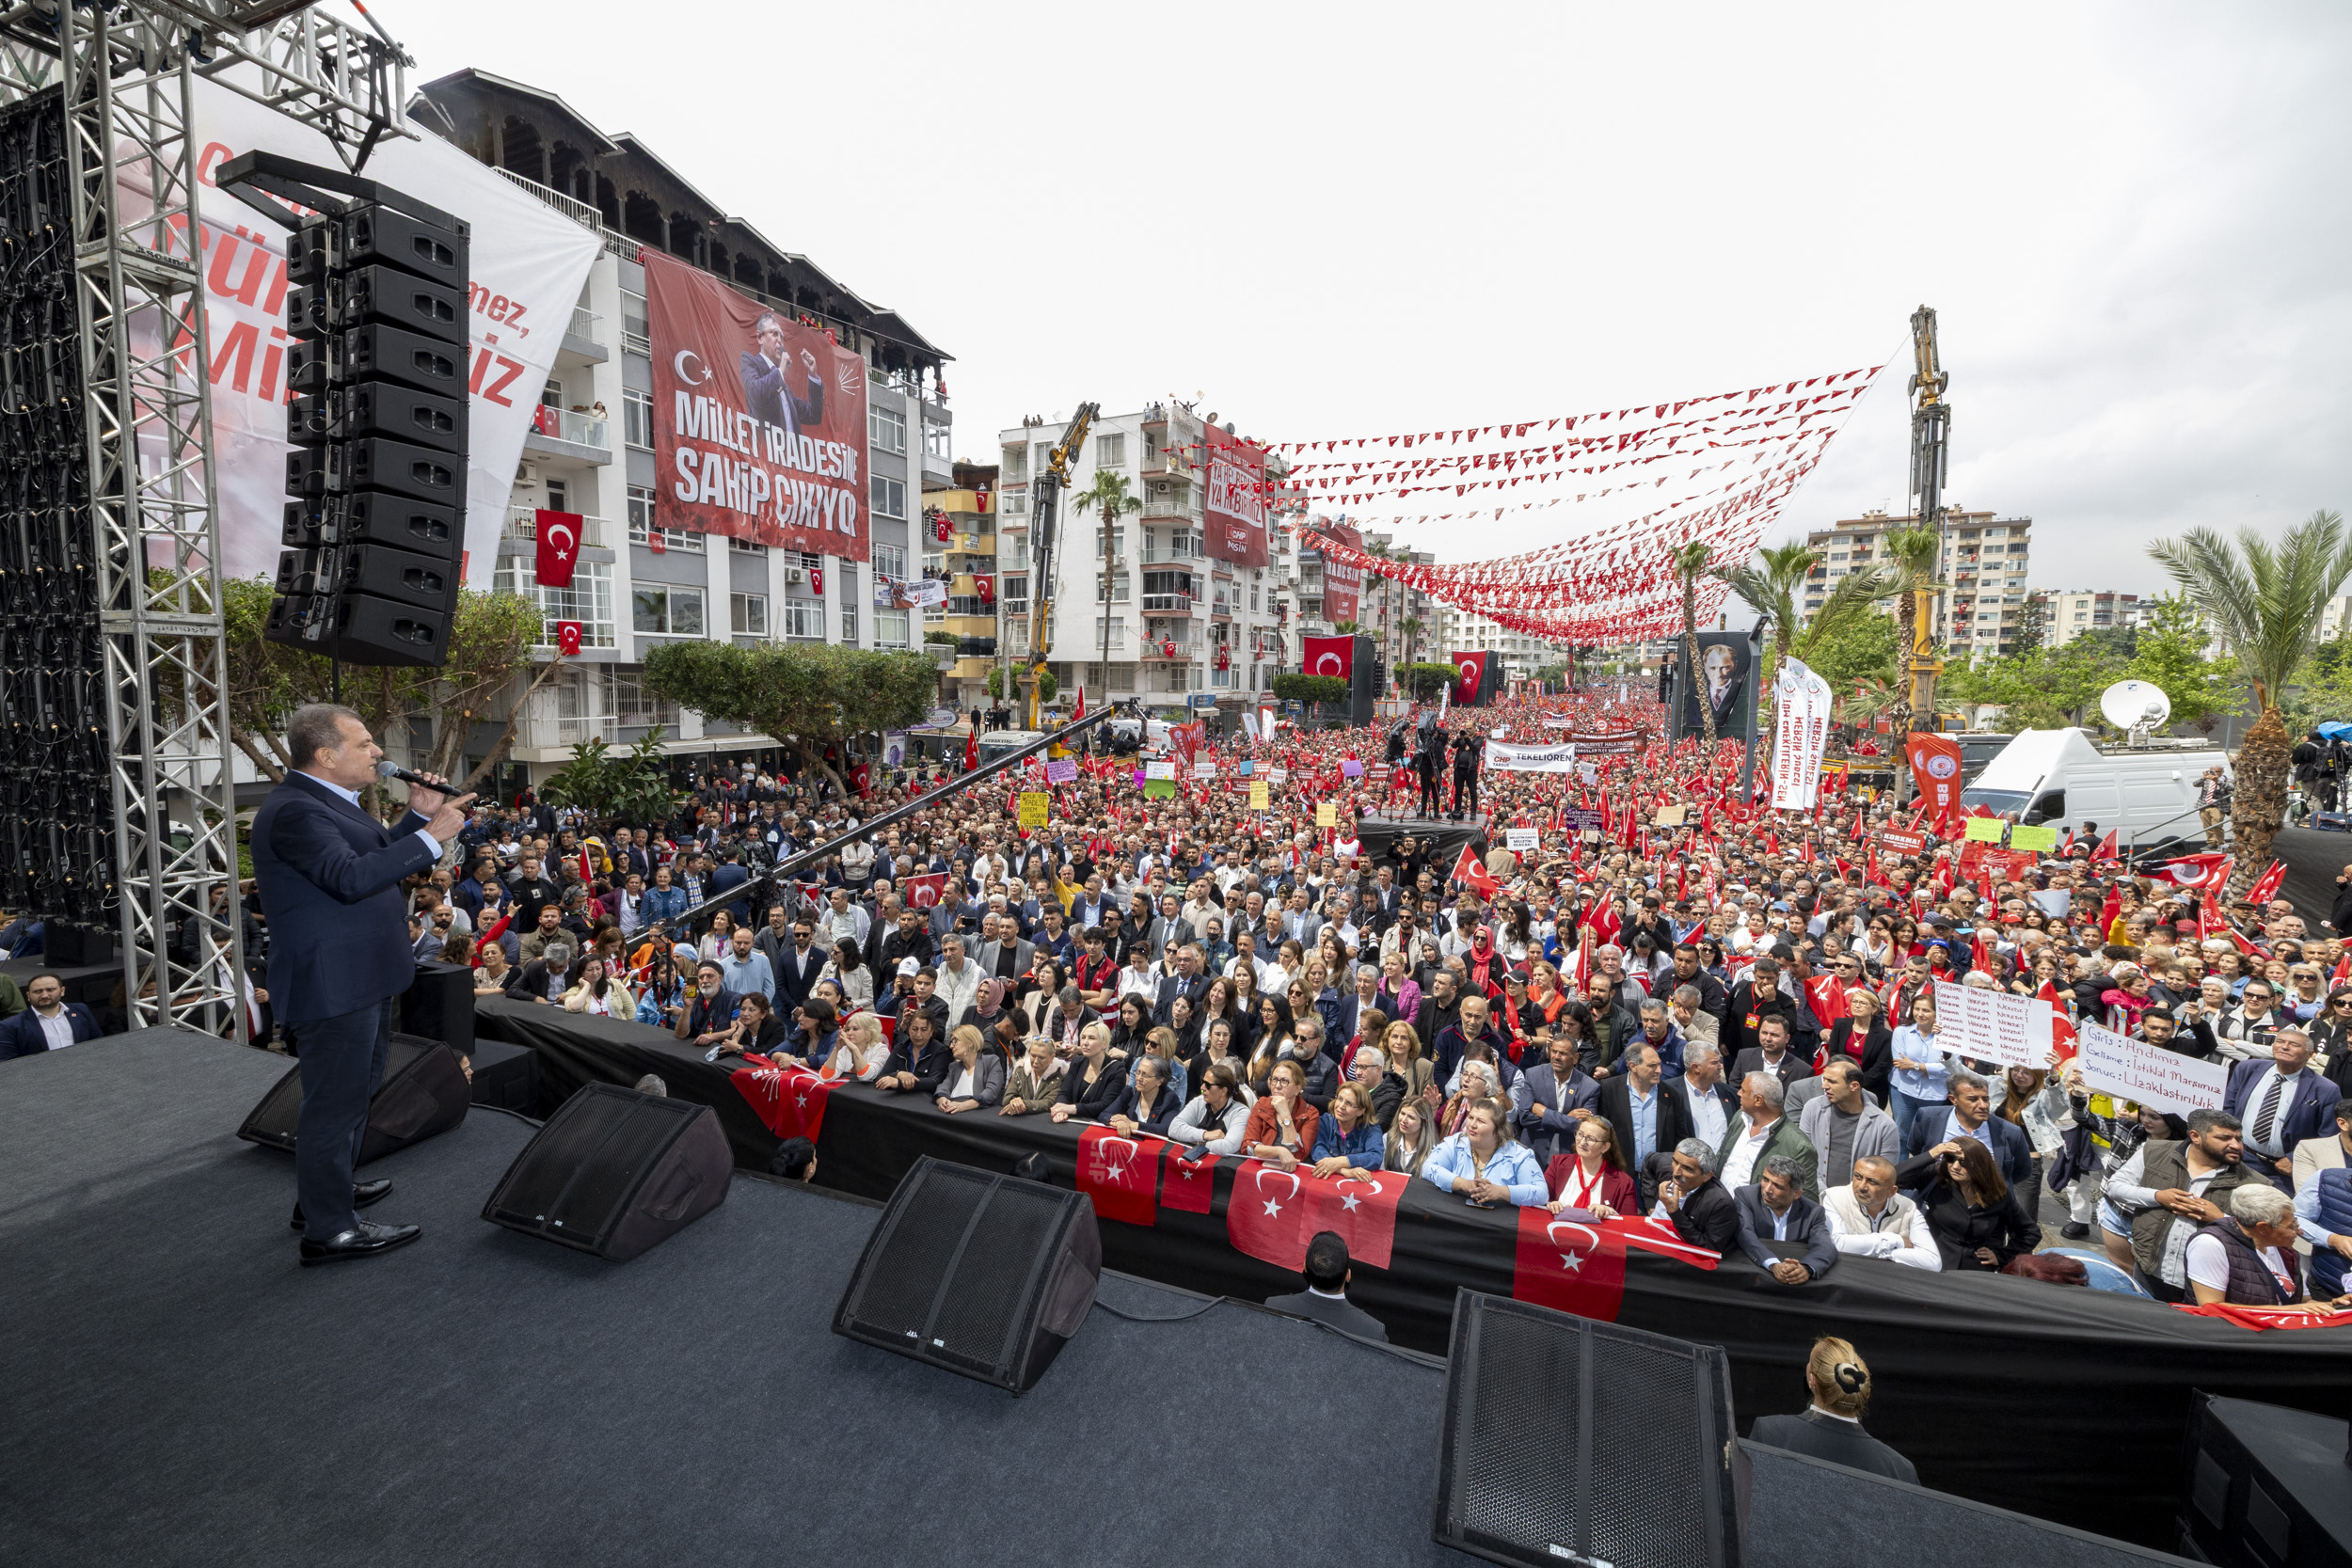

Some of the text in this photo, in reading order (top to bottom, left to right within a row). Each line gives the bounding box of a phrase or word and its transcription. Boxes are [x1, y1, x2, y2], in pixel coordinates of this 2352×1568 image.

[675, 390, 760, 458] MİLLET
[675, 447, 771, 516] SAHİP
[1212, 482, 1221, 507] YA
[1883, 833, 1921, 845] KORKMA!
[2125, 1039, 2181, 1068] Andımız
[1549, 1544, 1568, 1559] d&b
